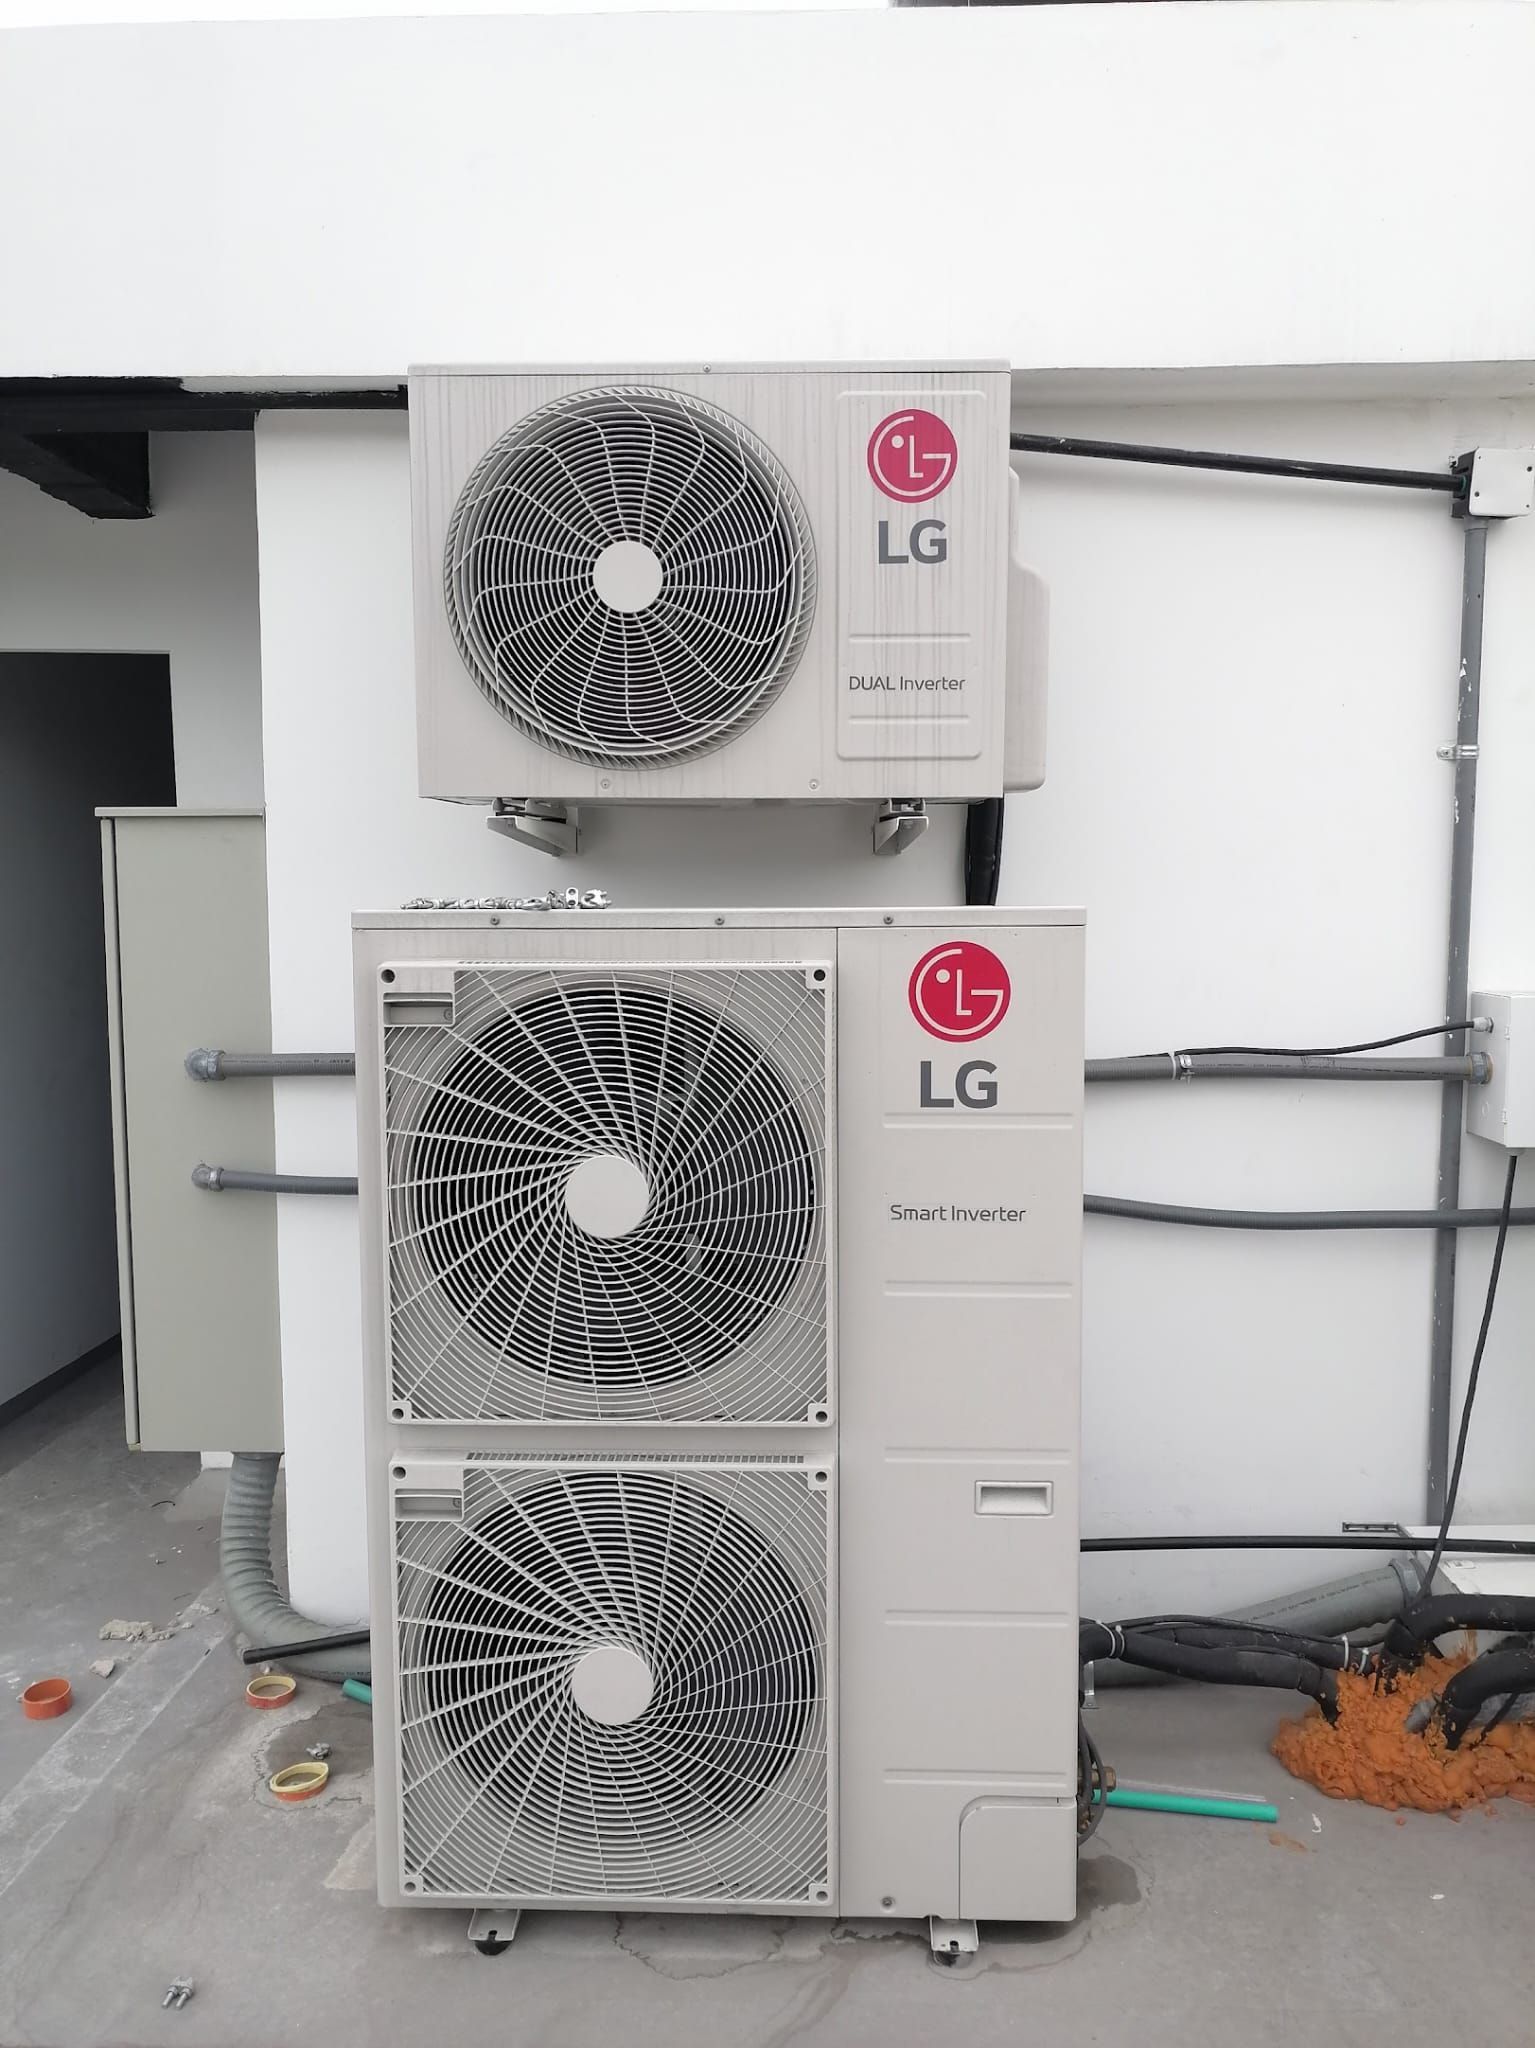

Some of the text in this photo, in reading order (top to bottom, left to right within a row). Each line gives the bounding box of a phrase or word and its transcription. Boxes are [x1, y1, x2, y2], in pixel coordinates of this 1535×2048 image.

[878, 519, 947, 565] LG
[848, 675, 966, 691] DUAL Inverter
[919, 1059, 998, 1109] LG
[890, 1204, 1027, 1222] Smart Inverter
